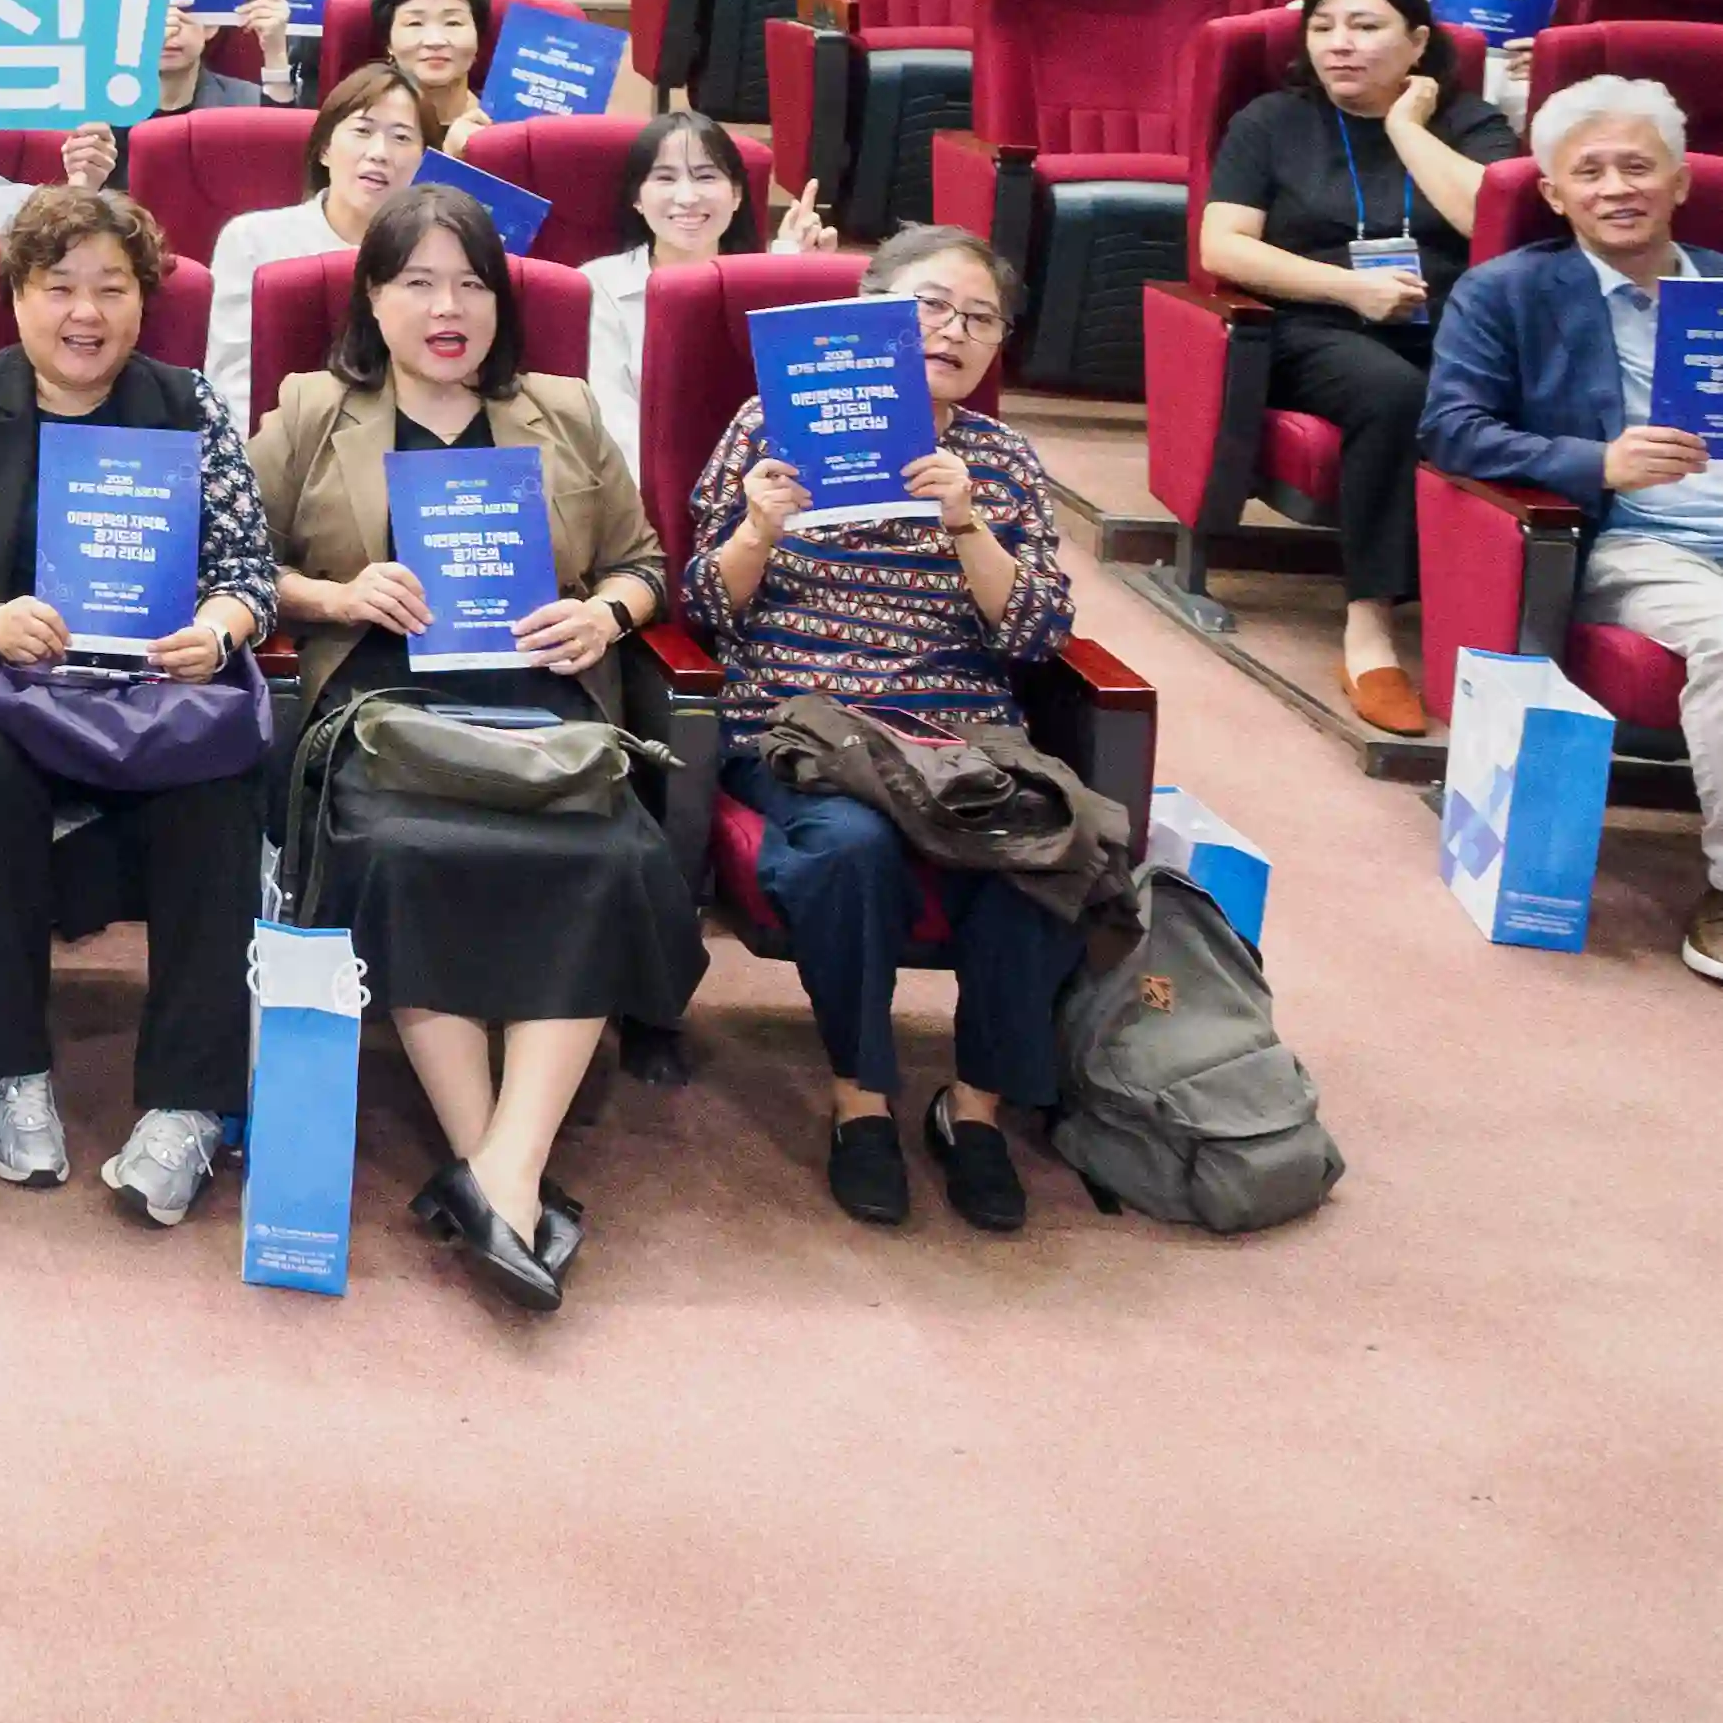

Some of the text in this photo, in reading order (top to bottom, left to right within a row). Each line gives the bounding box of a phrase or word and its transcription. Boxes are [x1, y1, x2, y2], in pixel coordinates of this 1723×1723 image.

[821, 402, 872, 419] 경기도의
[93, 529, 142, 545] 경기도의
[453, 547, 500, 563] 경기도의
